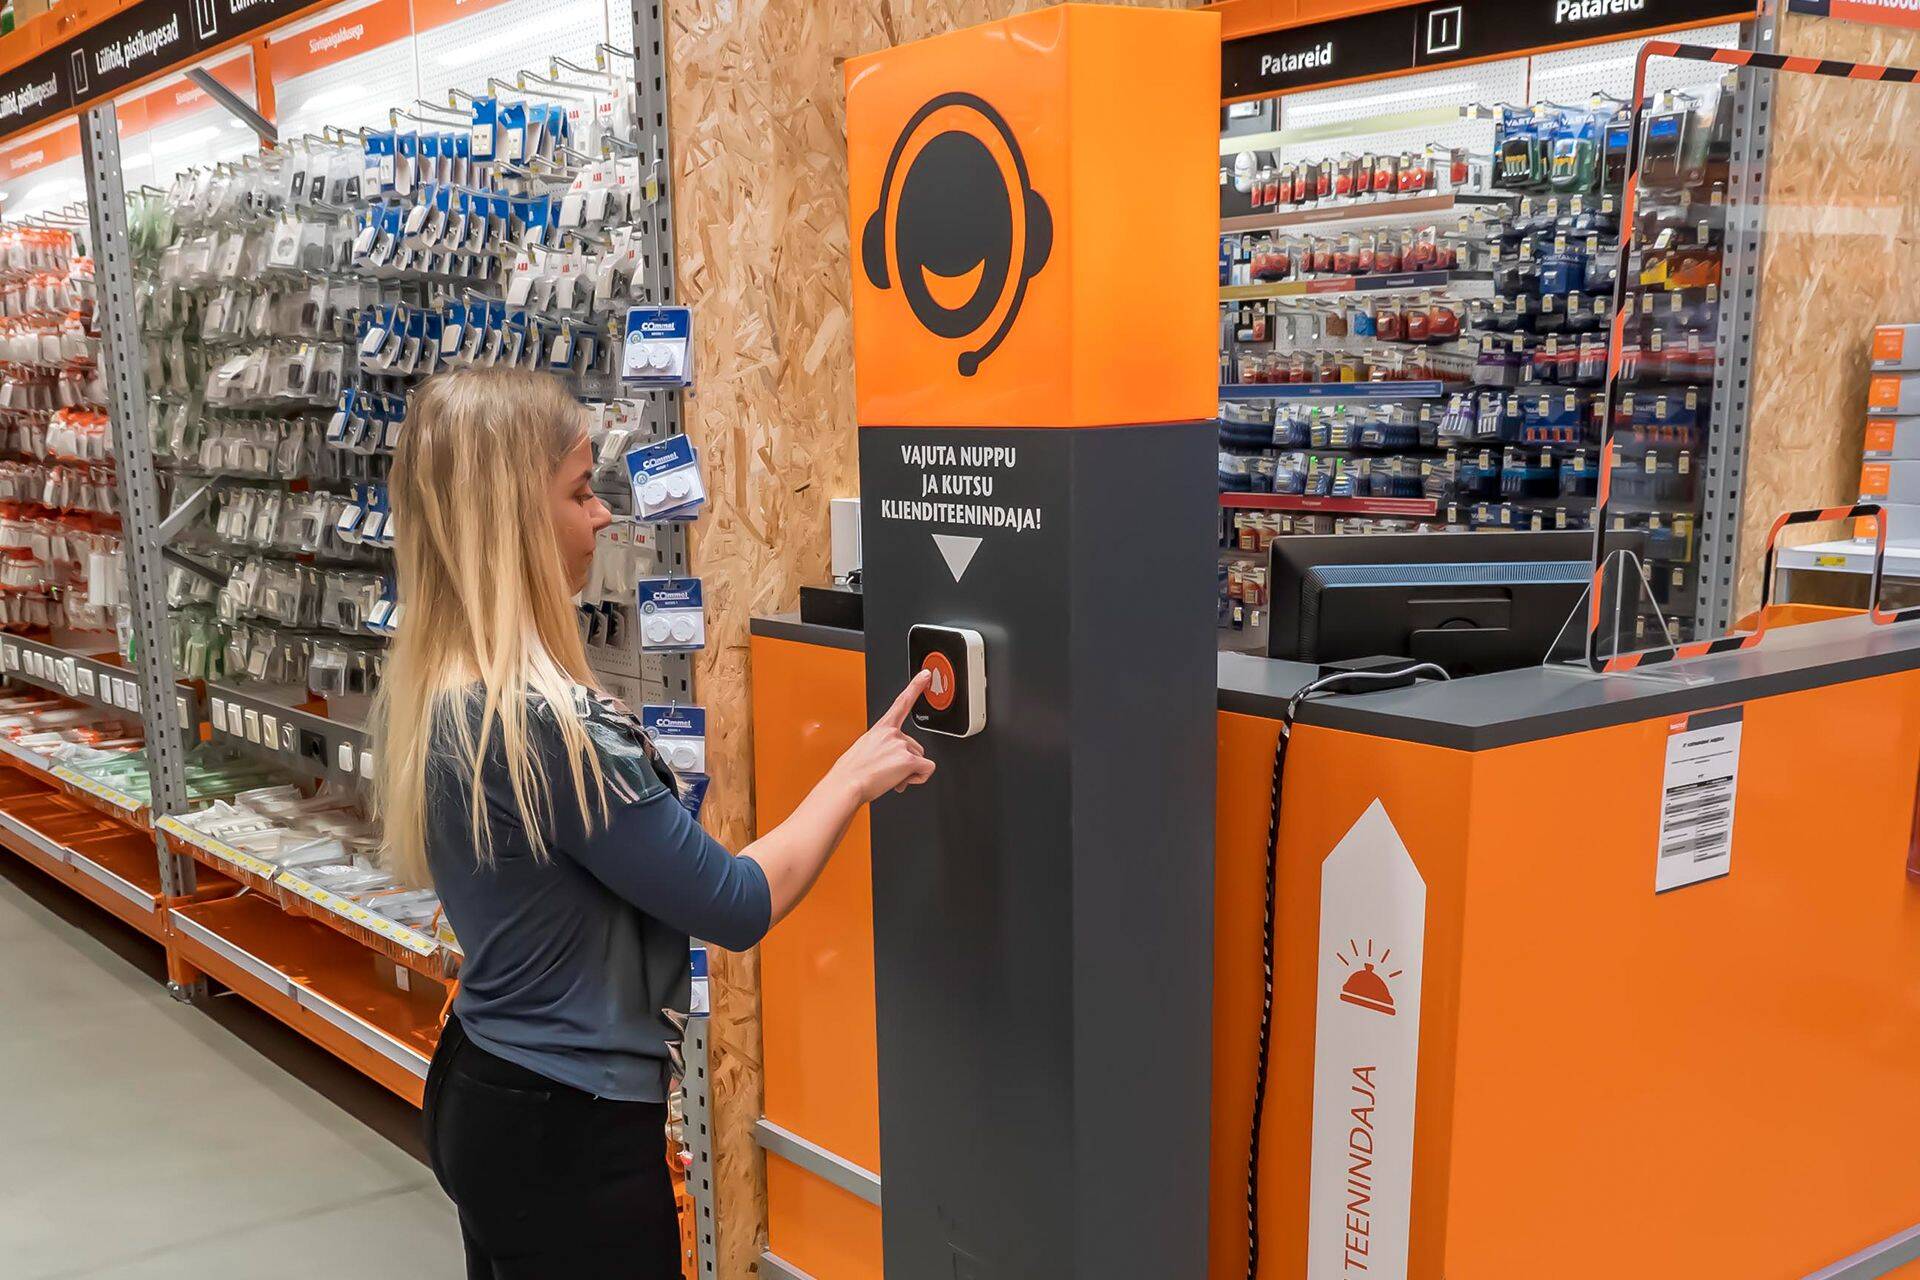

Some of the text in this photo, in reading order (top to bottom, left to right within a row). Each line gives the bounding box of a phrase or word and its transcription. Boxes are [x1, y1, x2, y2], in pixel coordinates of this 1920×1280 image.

[1260, 42, 1333, 76] Patareid
[901, 445, 1016, 469] VAJUTA NUPPU
[922, 474, 993, 497] JA KUTSU
[881, 499, 1041, 533] KLIENDITEENINDAJA!
[1344, 1065, 1377, 1271] TEENINDAJA
